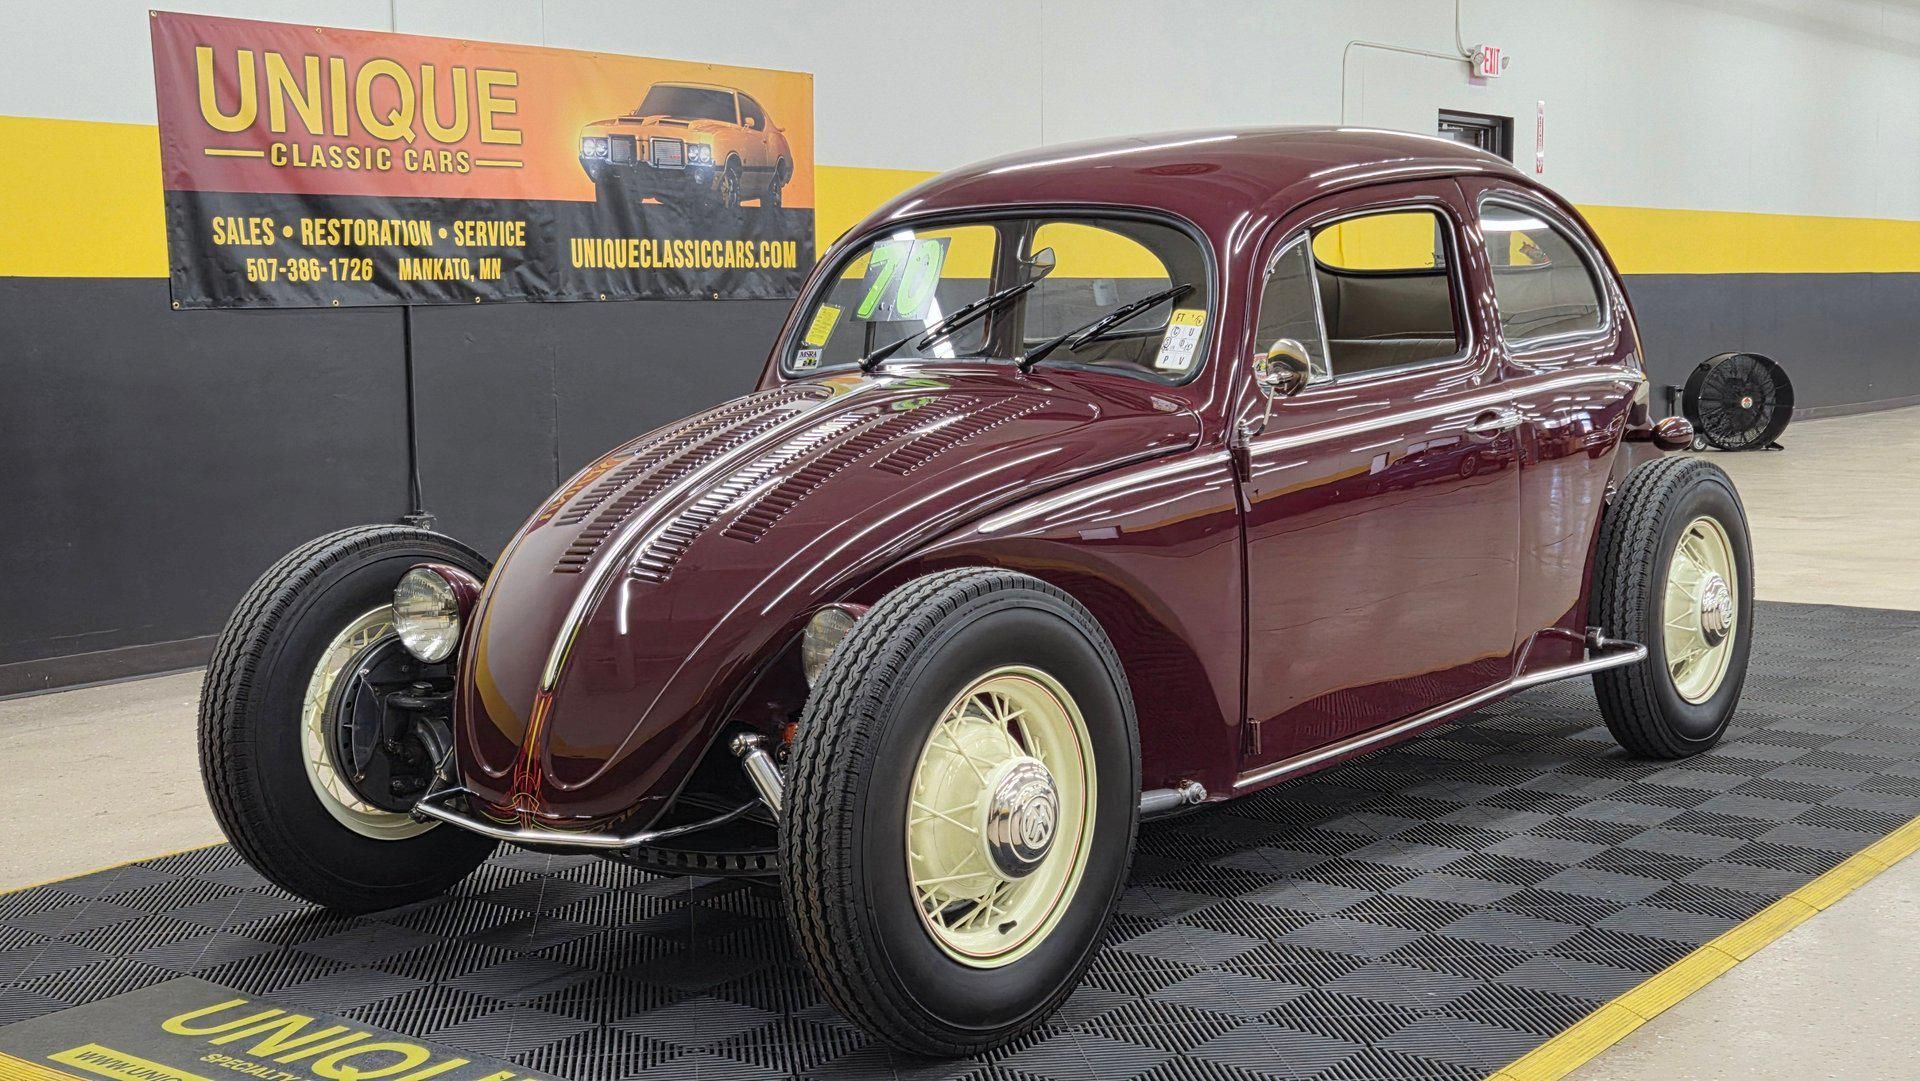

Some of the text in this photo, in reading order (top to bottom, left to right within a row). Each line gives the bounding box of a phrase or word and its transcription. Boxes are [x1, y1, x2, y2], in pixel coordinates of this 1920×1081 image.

[1484, 46, 1501, 75] EXIT
[195, 46, 522, 145] UNIQUE
[270, 142, 470, 174] CLASSIC CARS
[213, 217, 527, 247] SALES RESTORATION SERVICE
[246, 257, 502, 283] 507-386-1726 MANKATO, MN
[570, 238, 797, 270] UNIQUECLASSICCARS.COM
[857, 240, 943, 319] 70
[162, 999, 537, 1081] UNIQ
